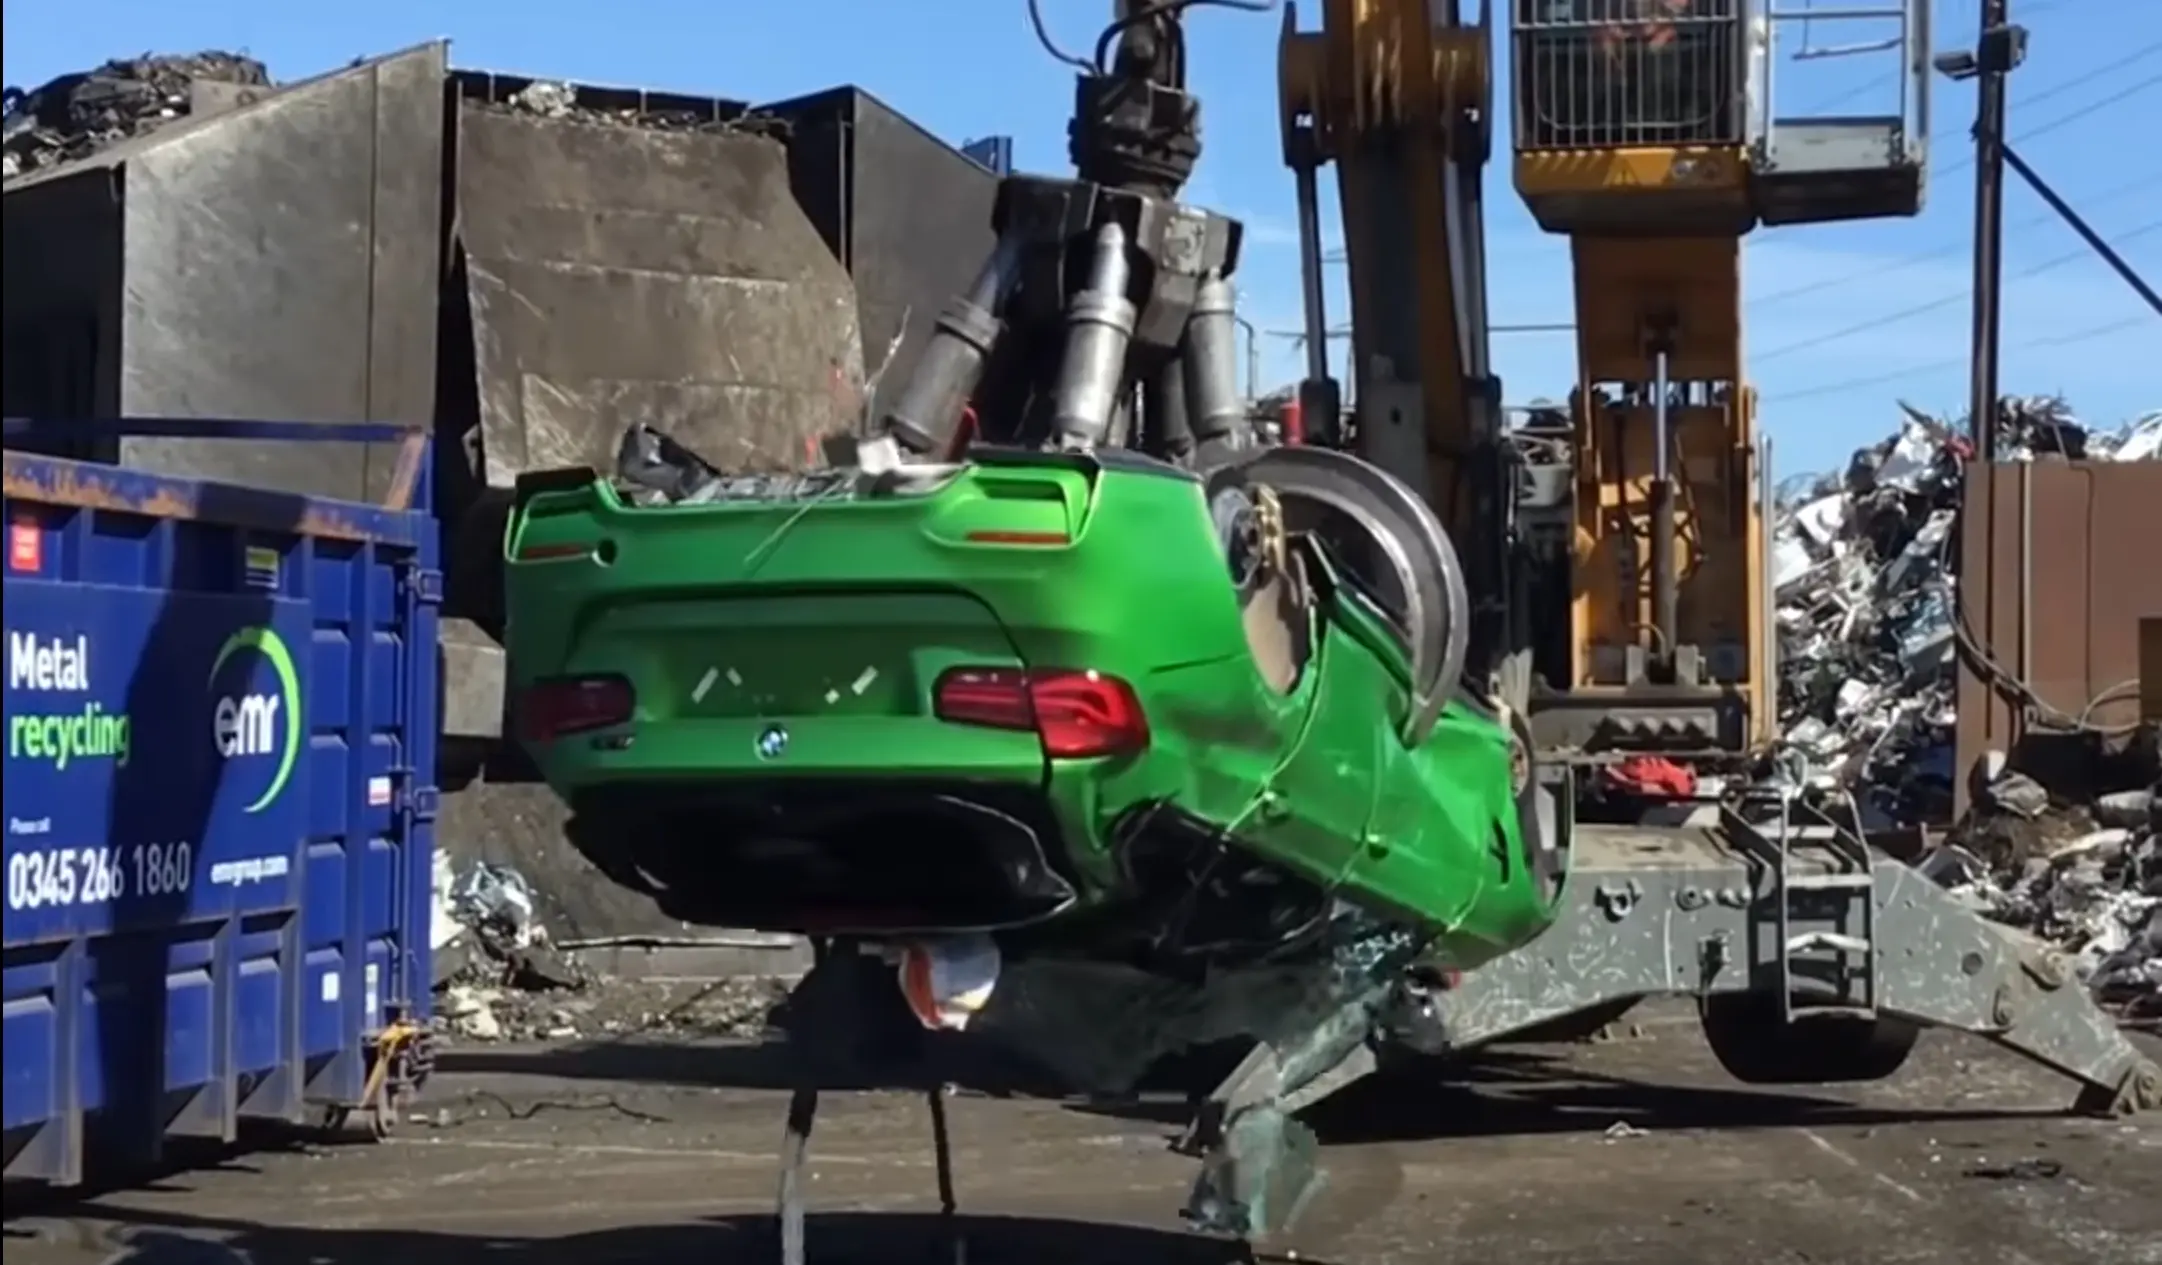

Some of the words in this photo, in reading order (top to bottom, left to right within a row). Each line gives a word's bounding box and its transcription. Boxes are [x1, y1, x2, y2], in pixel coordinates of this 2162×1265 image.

[10, 631, 88, 690] Metal
[10, 701, 130, 770] recycling
[214, 694, 279, 757] emr
[9, 849, 76, 909] 0345
[80, 847, 124, 903] 266
[133, 841, 191, 896] 1860
